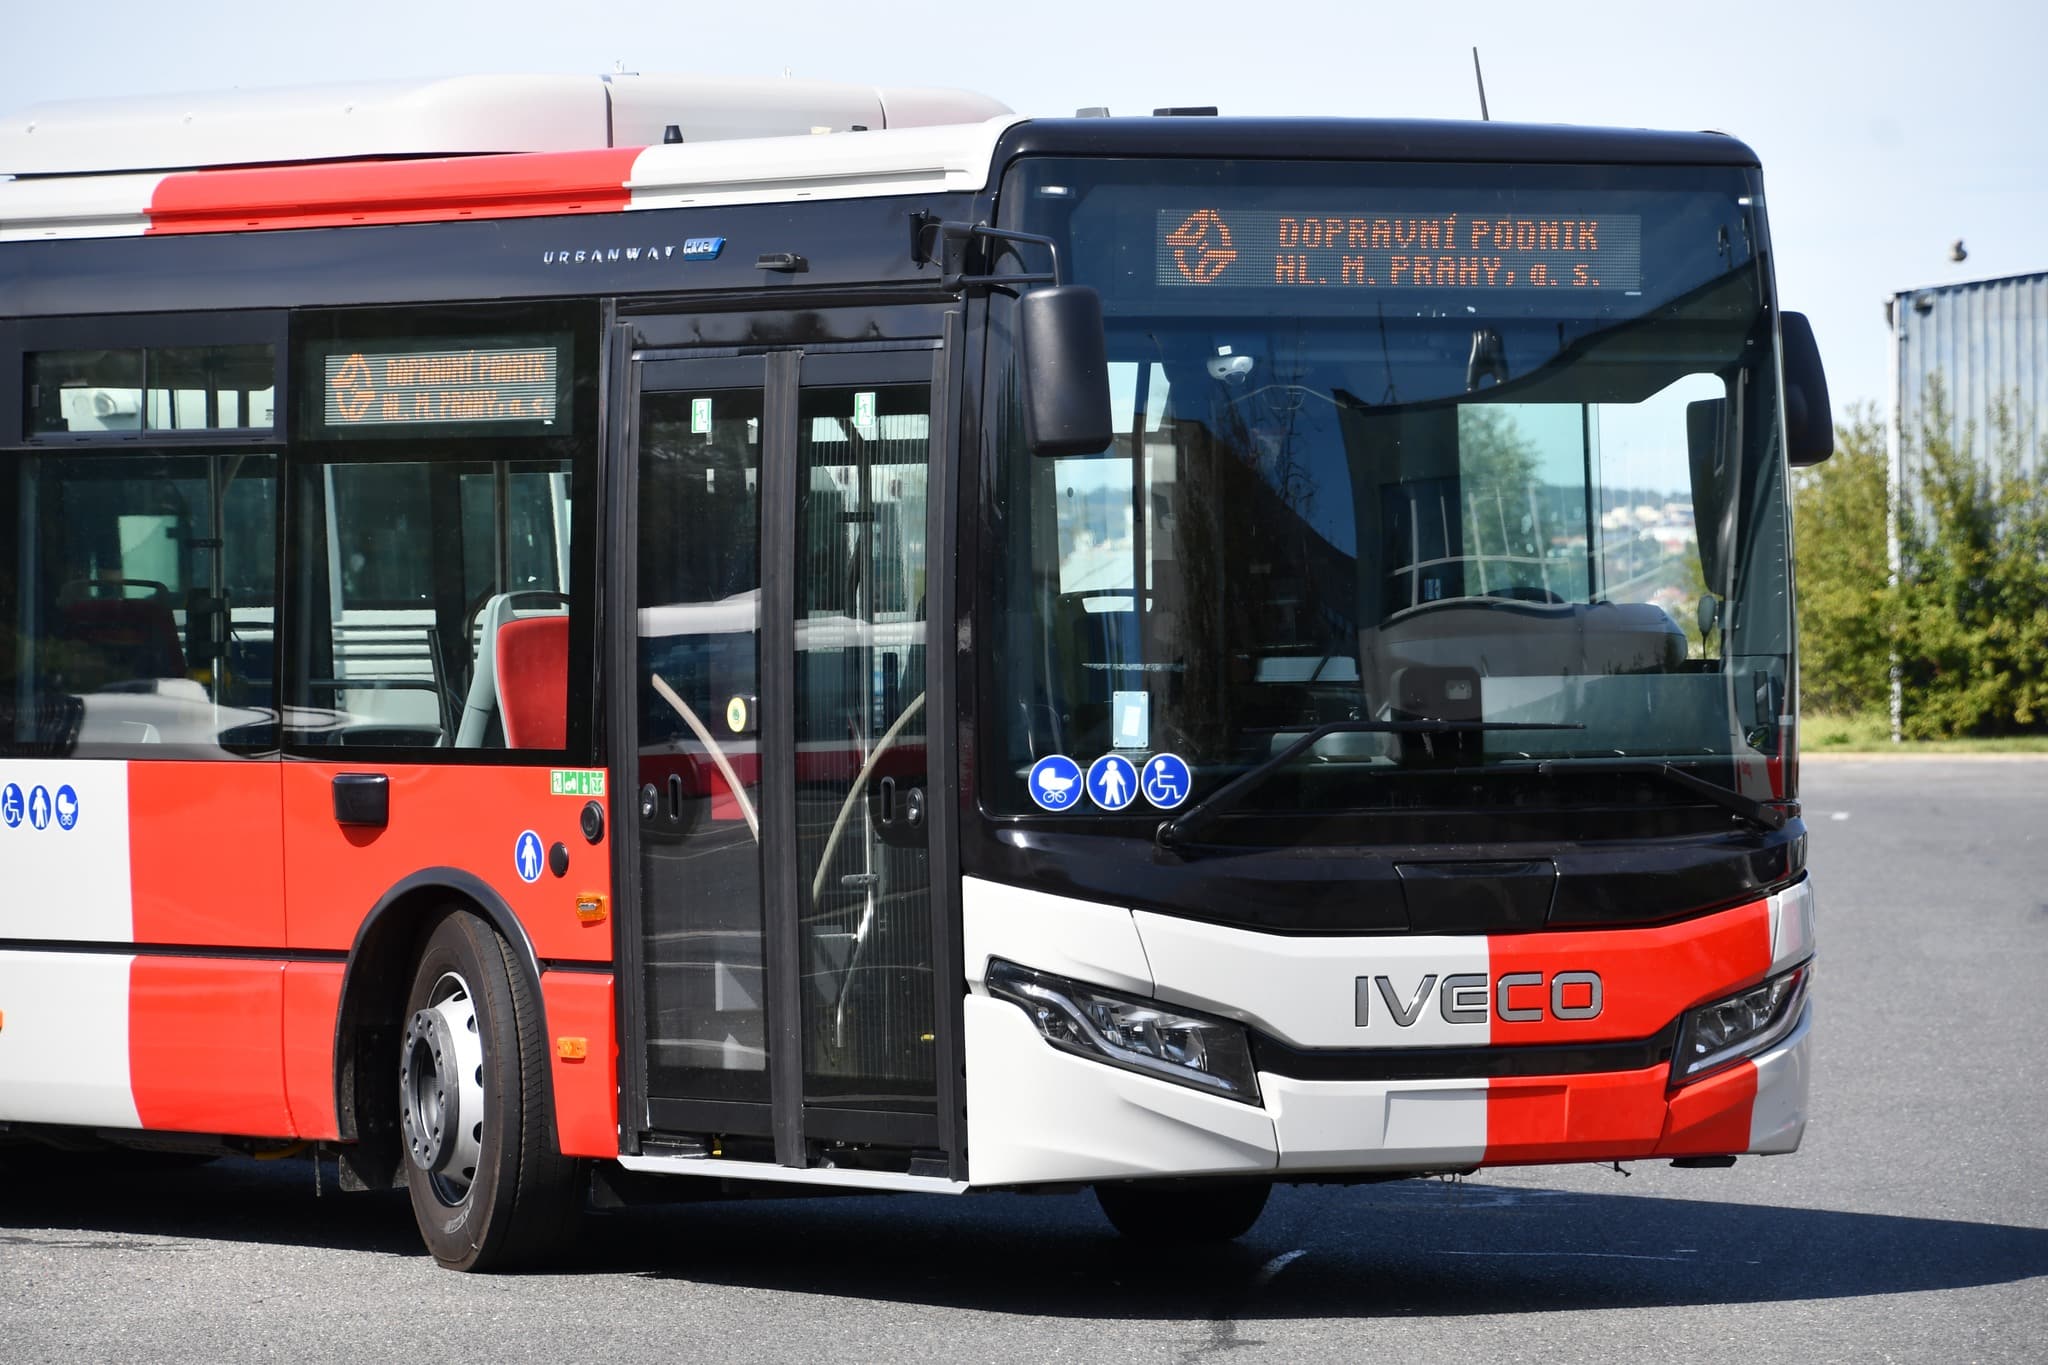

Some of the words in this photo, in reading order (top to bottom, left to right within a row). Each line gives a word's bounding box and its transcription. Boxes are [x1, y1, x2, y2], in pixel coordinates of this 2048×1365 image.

[1279, 212, 1457, 249] DOPRAVNÍ
[1471, 219, 1600, 250] PODNIK
[543, 245, 676, 265] URBANWAY
[1275, 255, 1328, 285] HL.
[1342, 255, 1376, 285] M.
[1390, 256, 1515, 286] PRAHY,
[1529, 263, 1559, 286] a.
[1572, 263, 1600, 286] s.
[1354, 970, 1604, 1028] IVECO
